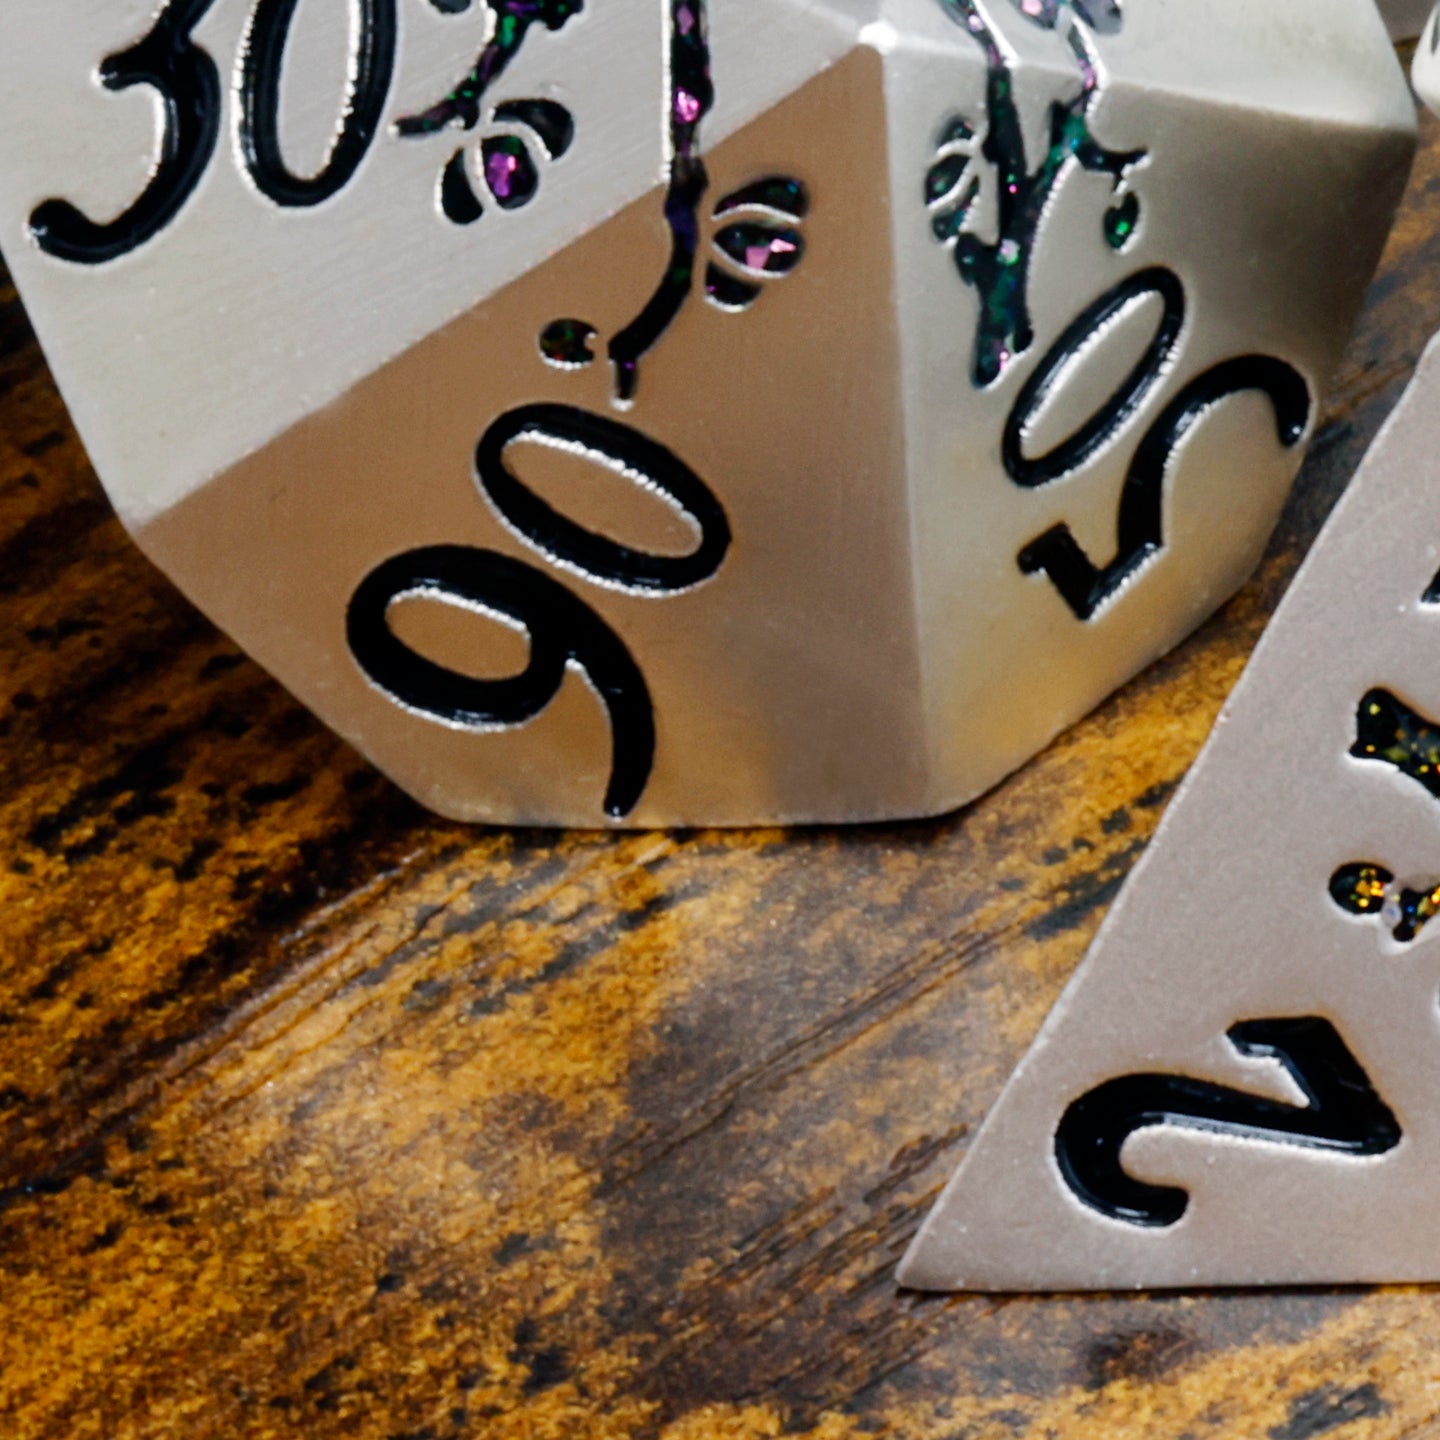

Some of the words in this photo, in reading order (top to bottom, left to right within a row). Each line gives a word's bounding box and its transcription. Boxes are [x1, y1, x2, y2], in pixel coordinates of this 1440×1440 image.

[345, 398, 732, 822] 90
[1002, 266, 1318, 622] 50
[1054, 1016, 1402, 1228] 2
